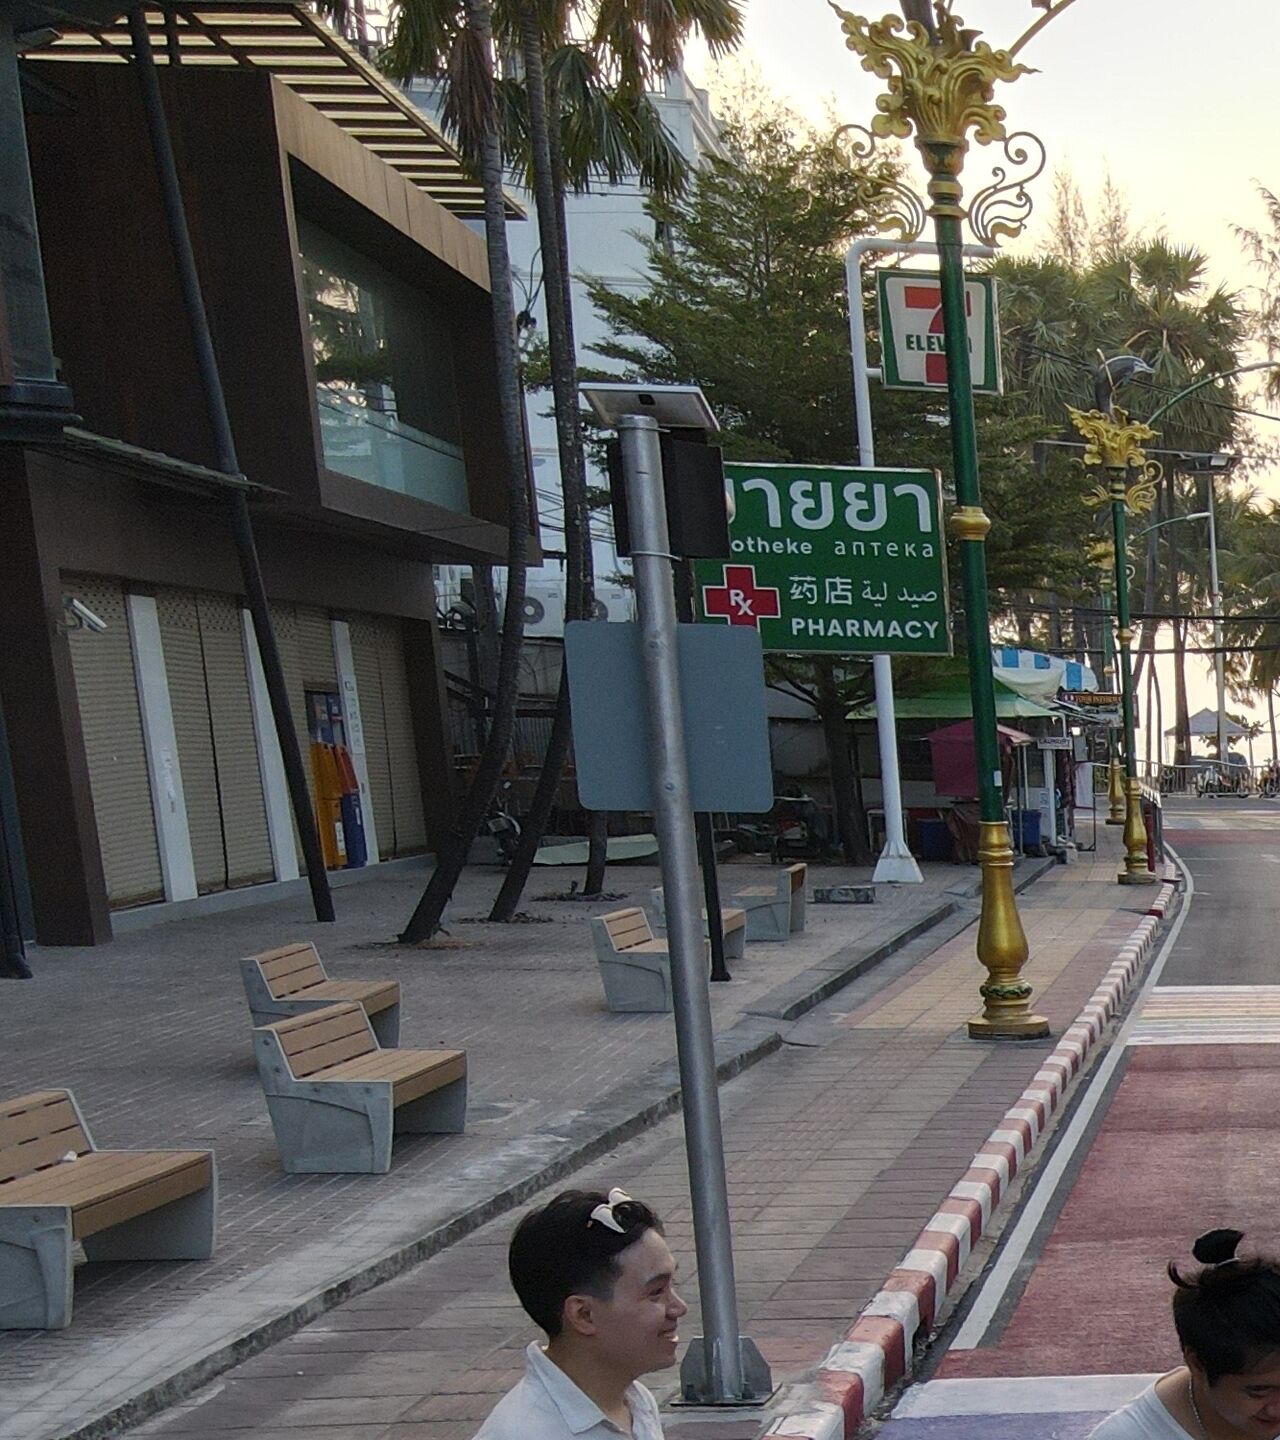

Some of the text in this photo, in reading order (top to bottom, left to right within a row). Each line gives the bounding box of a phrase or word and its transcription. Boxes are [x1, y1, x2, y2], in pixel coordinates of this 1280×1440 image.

[834, 540, 934, 558] аптека
[788, 574, 854, 606] 药店
[791, 617, 939, 639] PHARMACY
